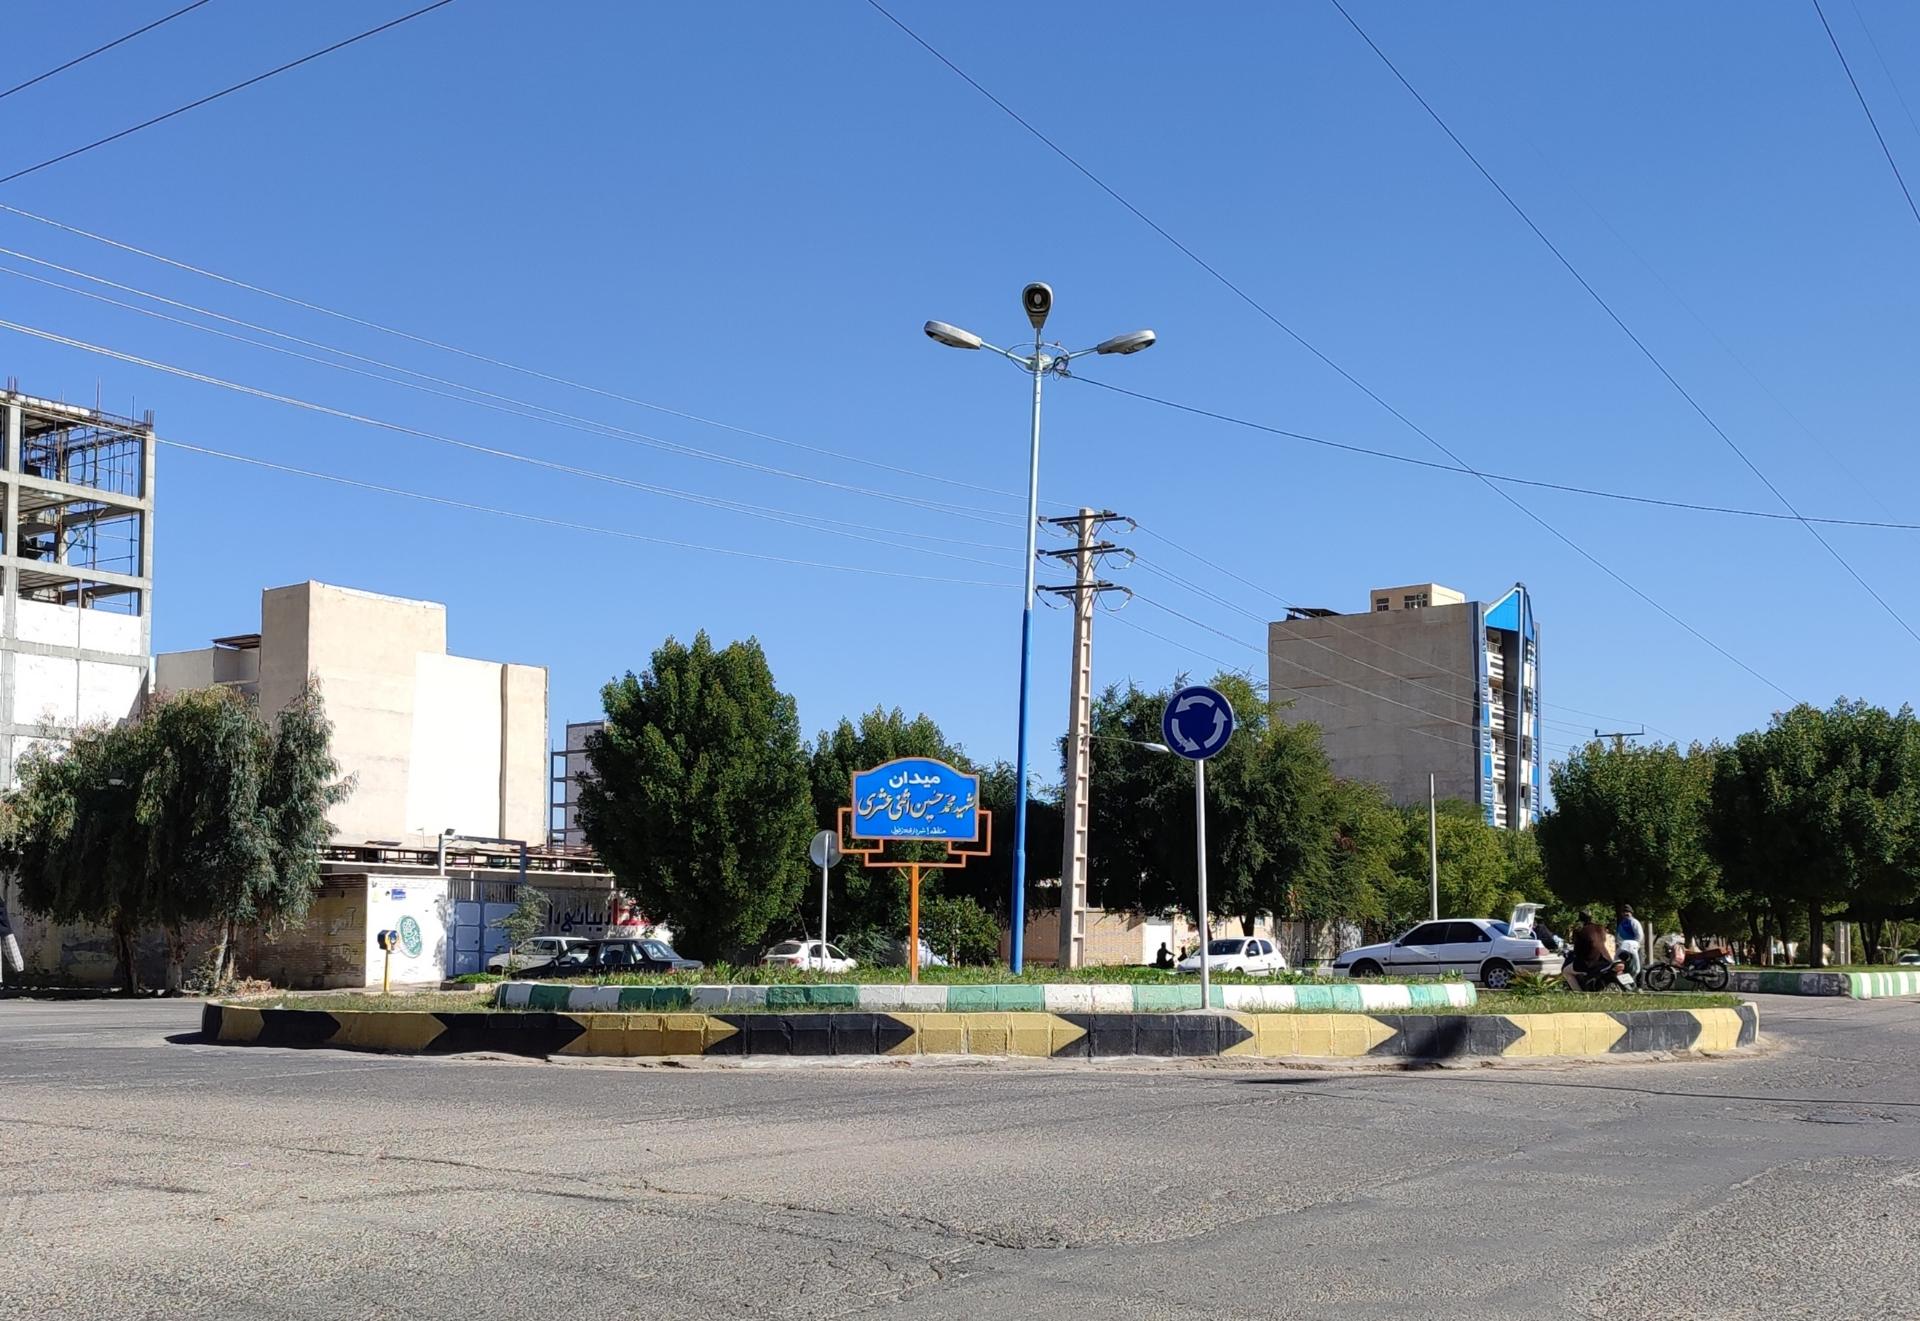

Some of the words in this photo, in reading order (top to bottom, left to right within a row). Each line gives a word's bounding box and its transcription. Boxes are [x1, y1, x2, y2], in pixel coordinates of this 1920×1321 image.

[888, 770, 941, 788] میدان
[858, 788, 893, 819] عشری
[909, 790, 943, 822] حسین
[939, 794, 956, 813] محمد
[953, 792, 975, 818] شهید
